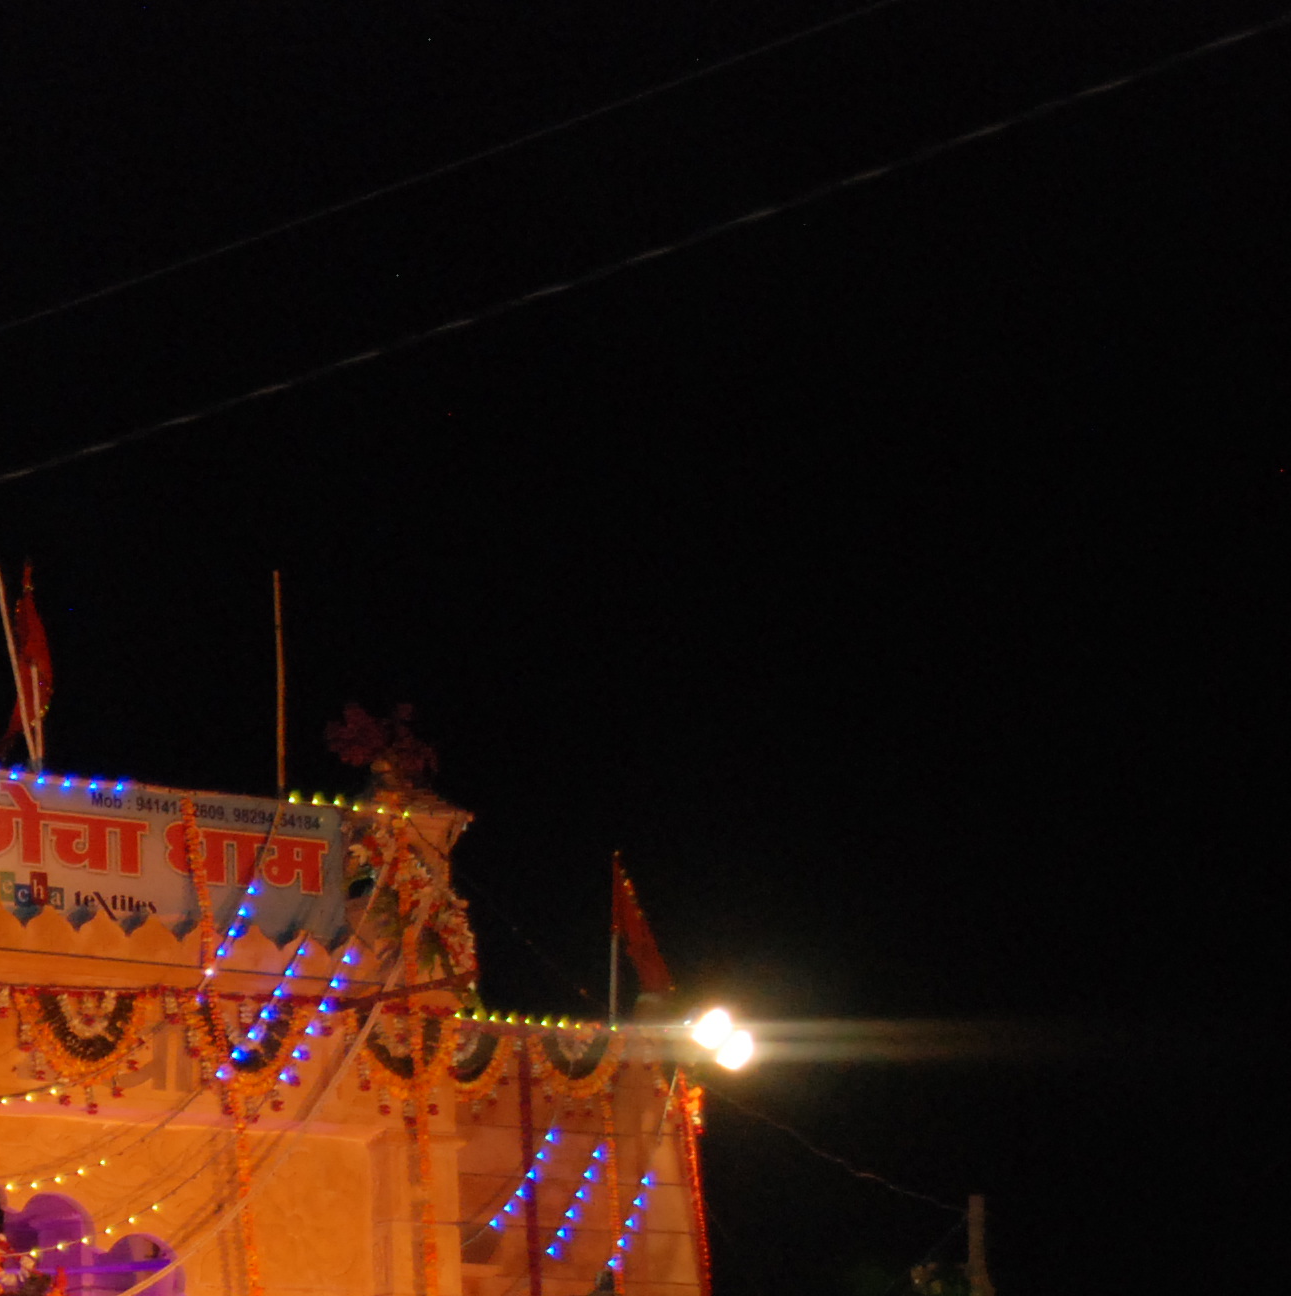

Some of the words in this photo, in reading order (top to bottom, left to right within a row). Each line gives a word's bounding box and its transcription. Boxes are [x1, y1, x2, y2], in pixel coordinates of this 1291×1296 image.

[92, 792, 122, 808] Mob
[165, 819, 329, 895] धाम
[74, 888, 158, 920] textiles
